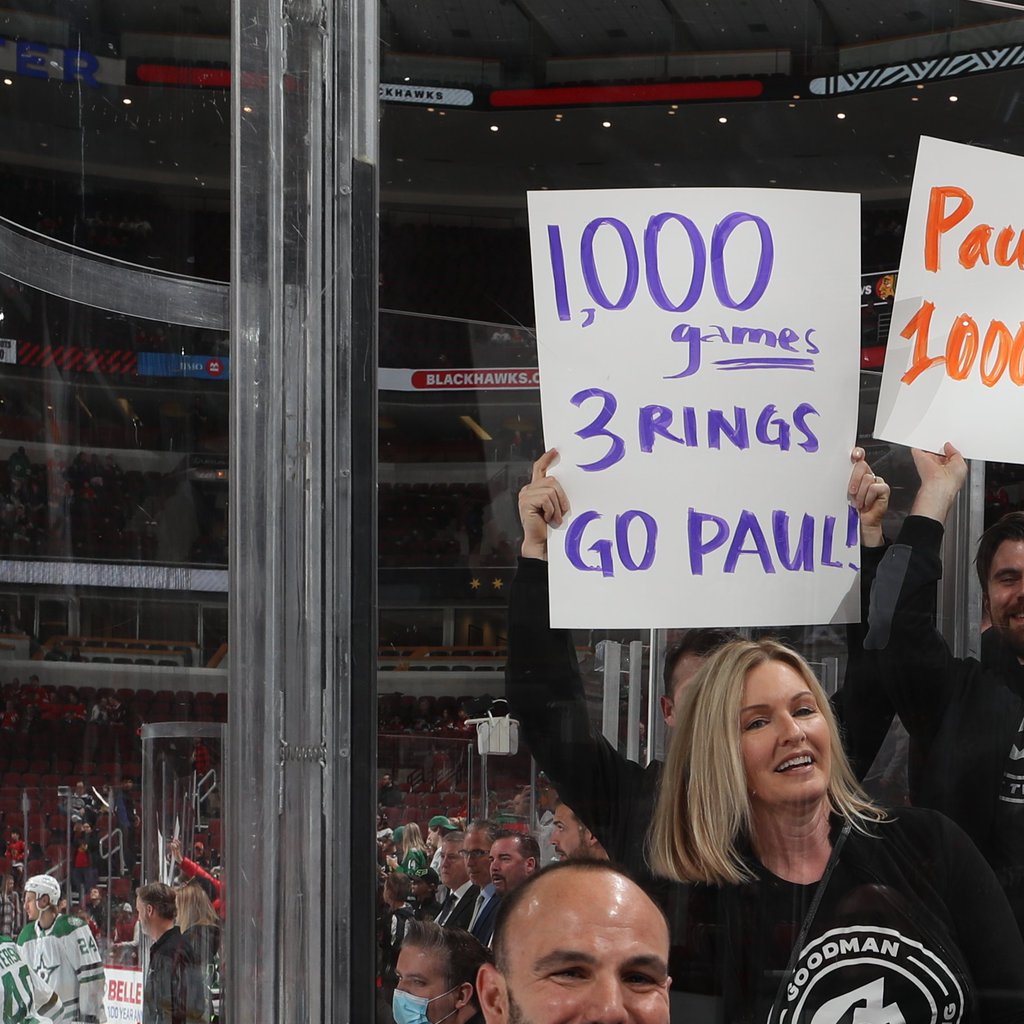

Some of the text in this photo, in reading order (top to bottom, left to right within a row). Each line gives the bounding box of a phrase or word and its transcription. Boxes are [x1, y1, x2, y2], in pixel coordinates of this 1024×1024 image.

[548, 211, 775, 327] 1,000
[663, 321, 820, 379] games
[569, 387, 821, 472] 3 RINGS
[565, 507, 861, 578] GO PAUL!
[77, 938, 98, 956] 24
[787, 937, 899, 1001] GOODMAN
[108, 979, 143, 1005] BELLE
